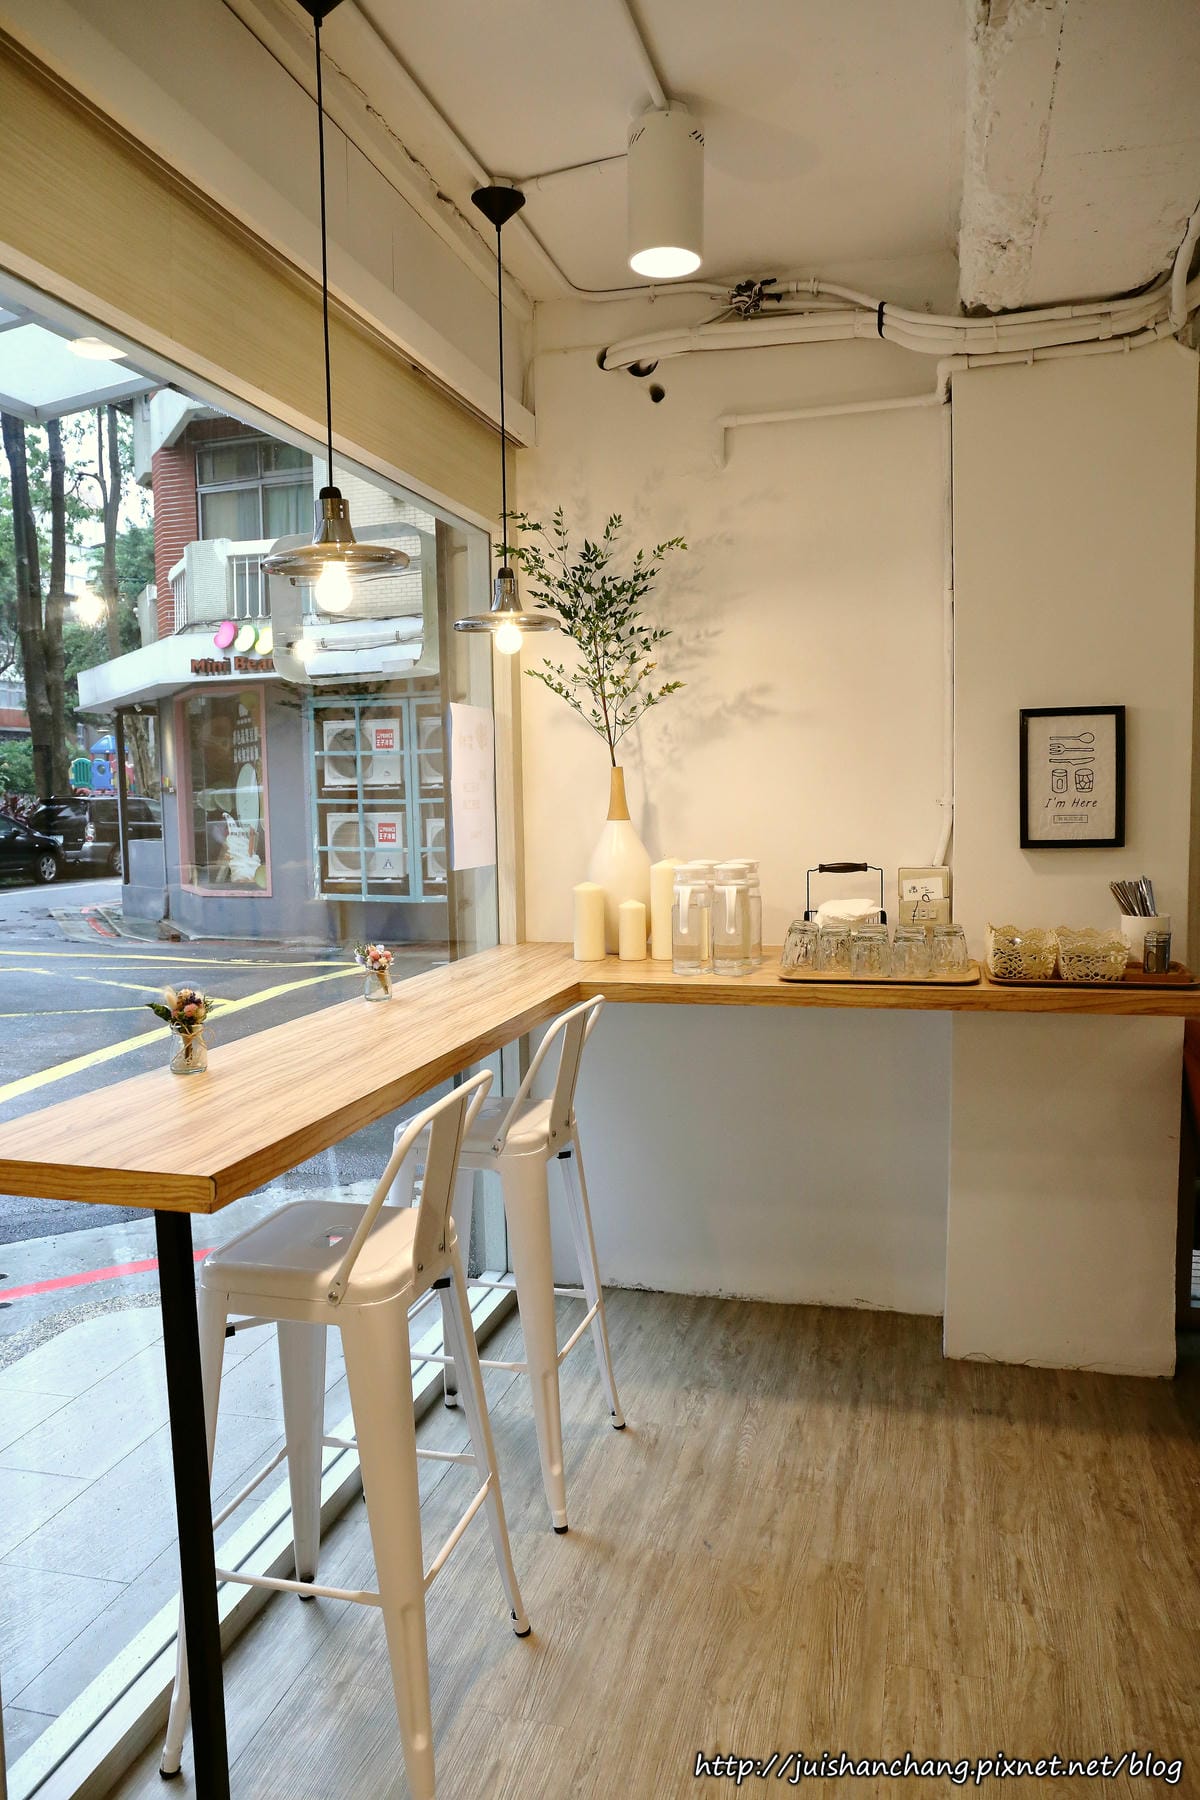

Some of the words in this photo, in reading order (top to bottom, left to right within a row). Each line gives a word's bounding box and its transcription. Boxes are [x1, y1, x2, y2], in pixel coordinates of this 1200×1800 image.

[191, 656, 231, 675] Mini
[1045, 797, 1066, 808] I'm
[1071, 797, 1098, 808] Here
